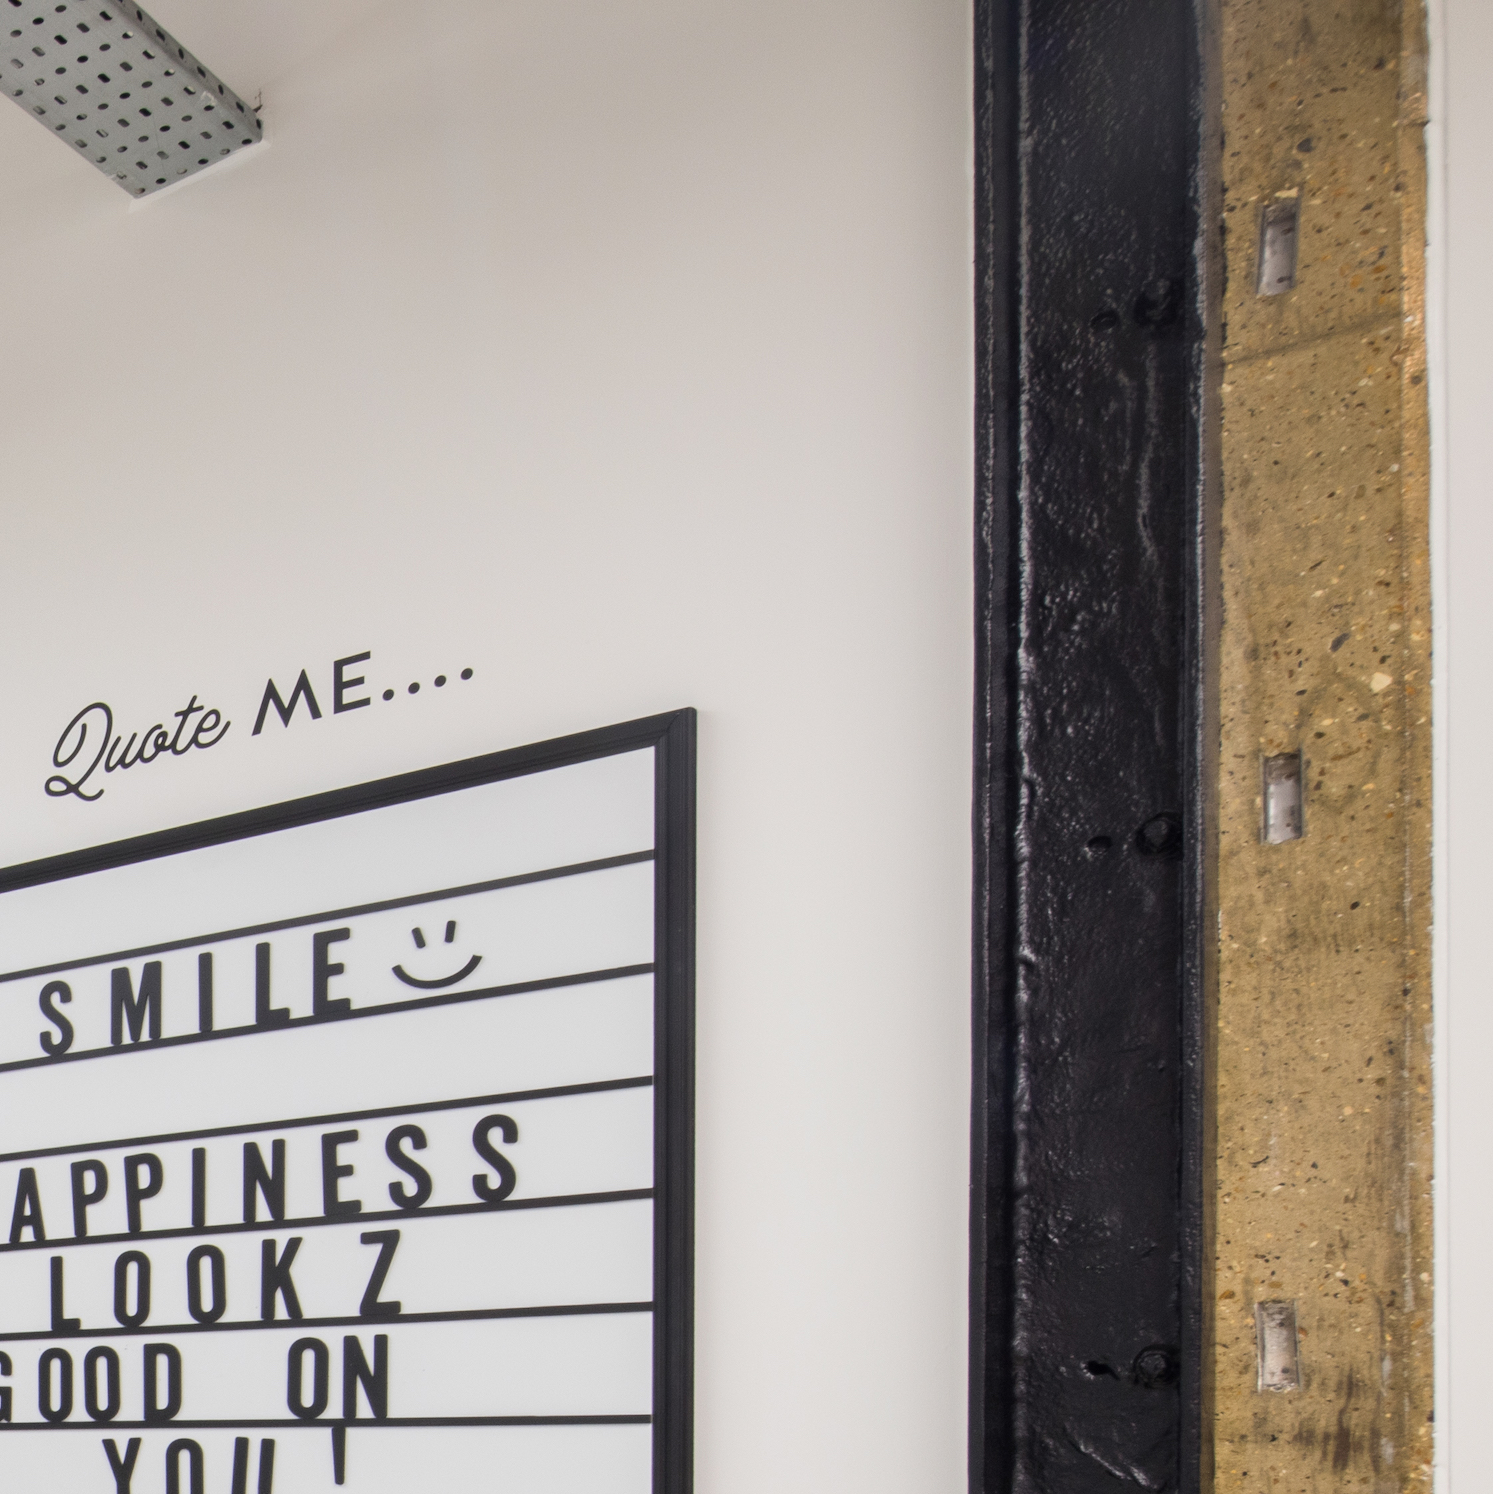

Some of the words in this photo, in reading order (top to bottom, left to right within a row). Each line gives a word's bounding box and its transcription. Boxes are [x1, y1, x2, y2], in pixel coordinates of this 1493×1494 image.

[44, 695, 231, 802] Quote
[38, 927, 353, 1057] SMILE
[286, 1334, 391, 1421] ON
